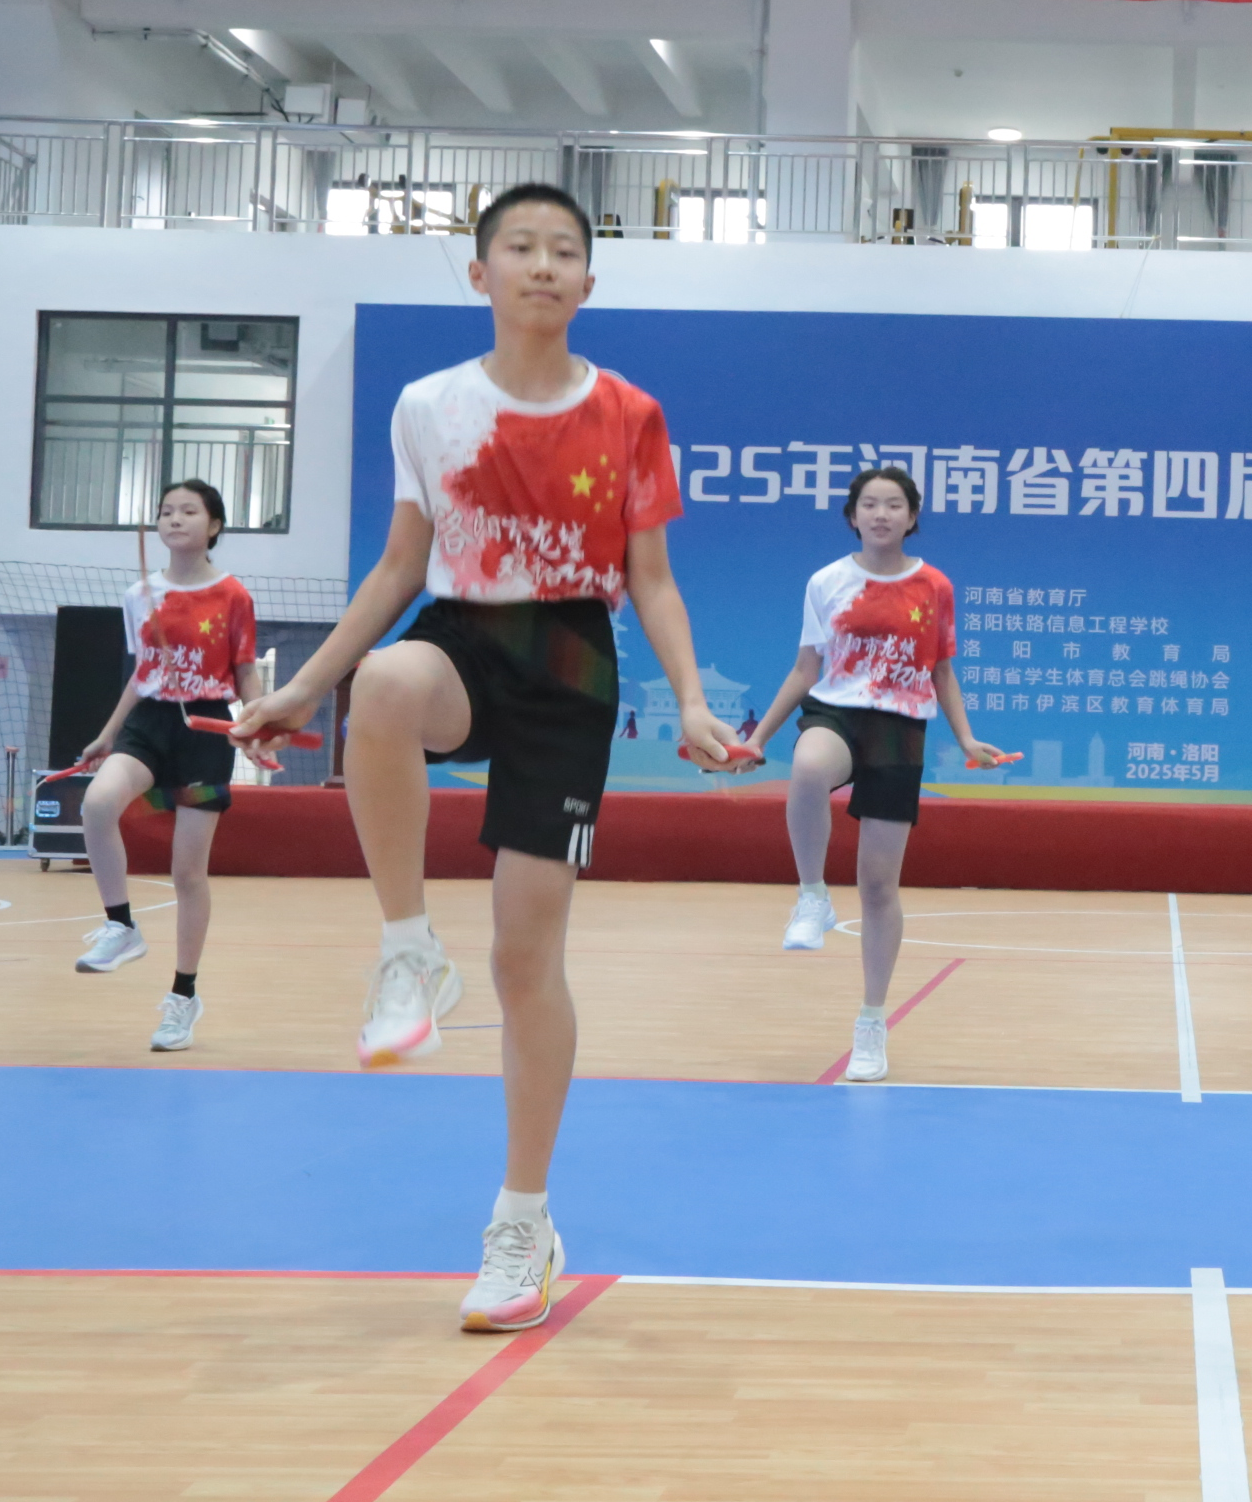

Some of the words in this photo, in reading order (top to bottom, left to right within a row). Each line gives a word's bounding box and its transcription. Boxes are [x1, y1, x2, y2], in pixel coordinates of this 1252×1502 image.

[964, 586, 1088, 608] 河南省教育厅
[963, 613, 1170, 636] 洛阳铁路信息工程学校
[962, 639, 1231, 664] 洛阳市教育局
[961, 665, 1231, 691] 河南省学生体育总会跳绳协会
[961, 692, 1230, 717] 洛阳市伊滨区教育体育局
[1125, 763, 1219, 782] 2025年5月
